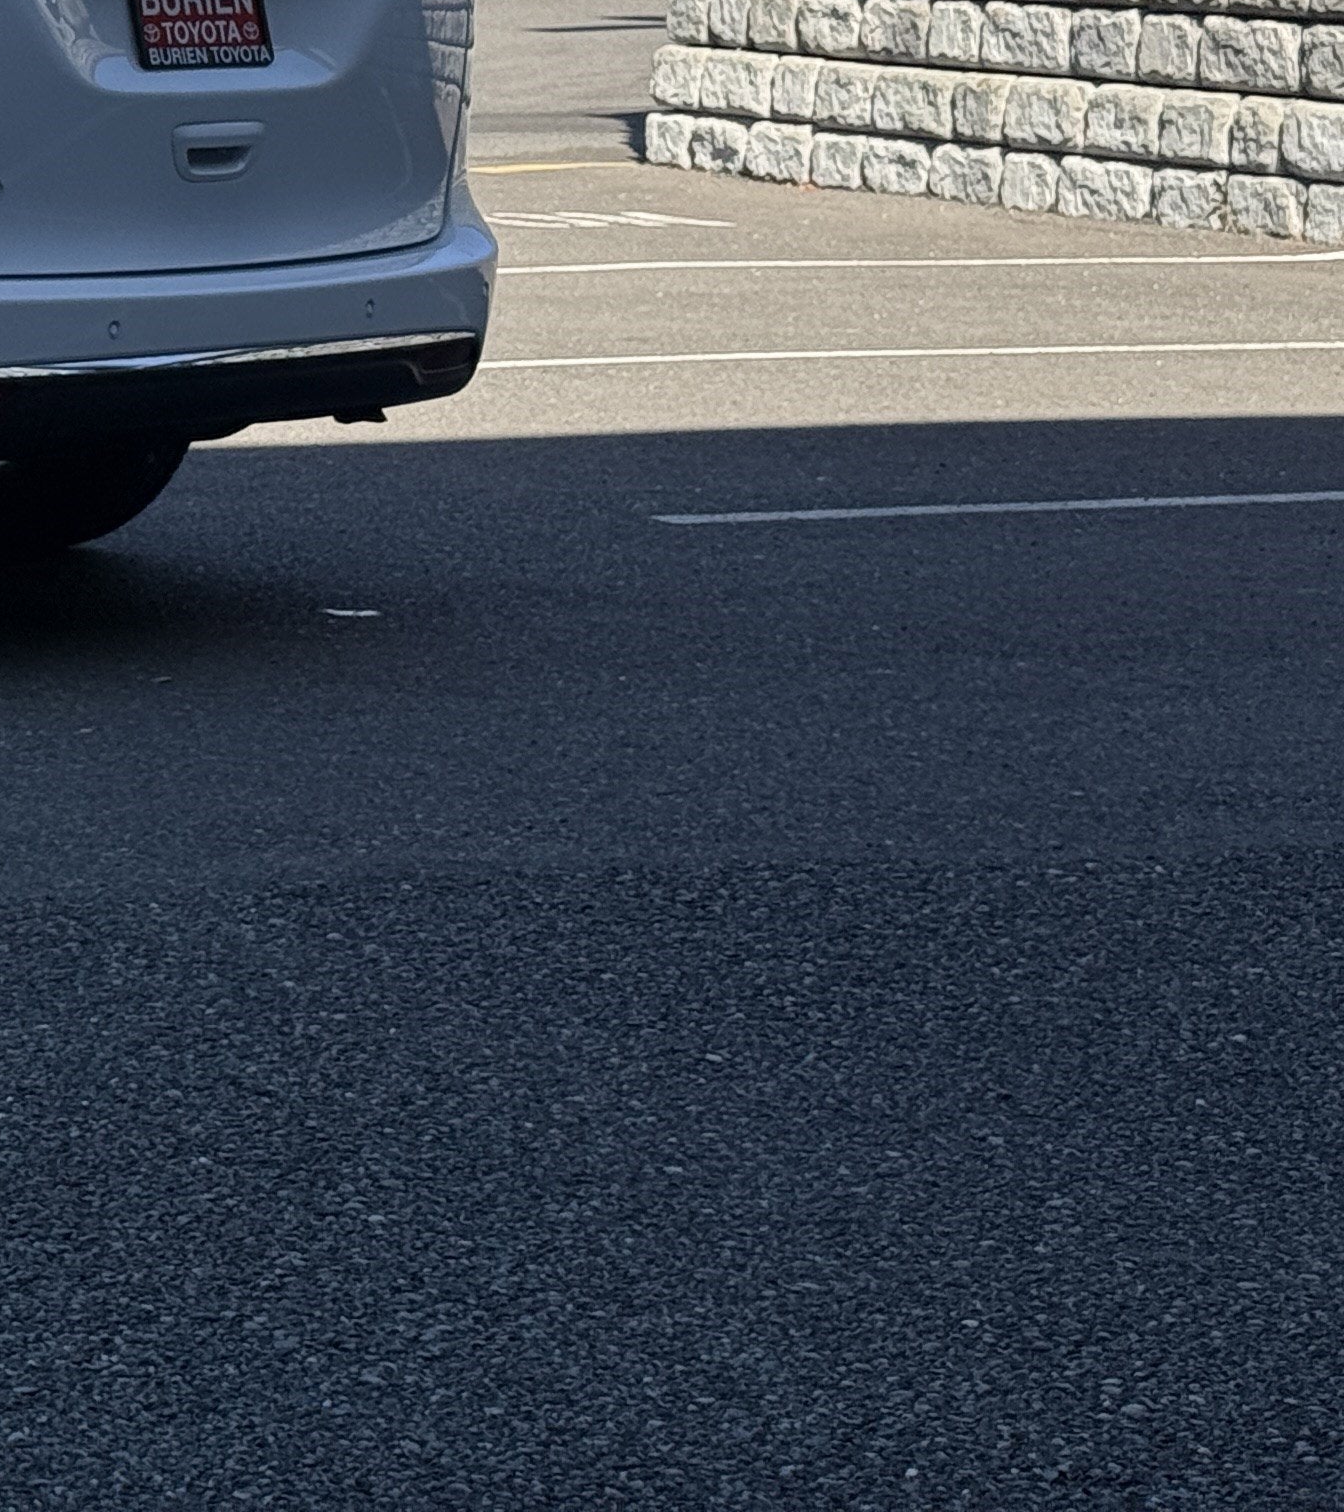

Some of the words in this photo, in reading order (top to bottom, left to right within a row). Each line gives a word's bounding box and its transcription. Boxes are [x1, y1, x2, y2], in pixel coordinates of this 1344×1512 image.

[161, 20, 243, 45] TOYOTA
[149, 46, 209, 66] BURIEN
[209, 44, 272, 64] TOYOTA
